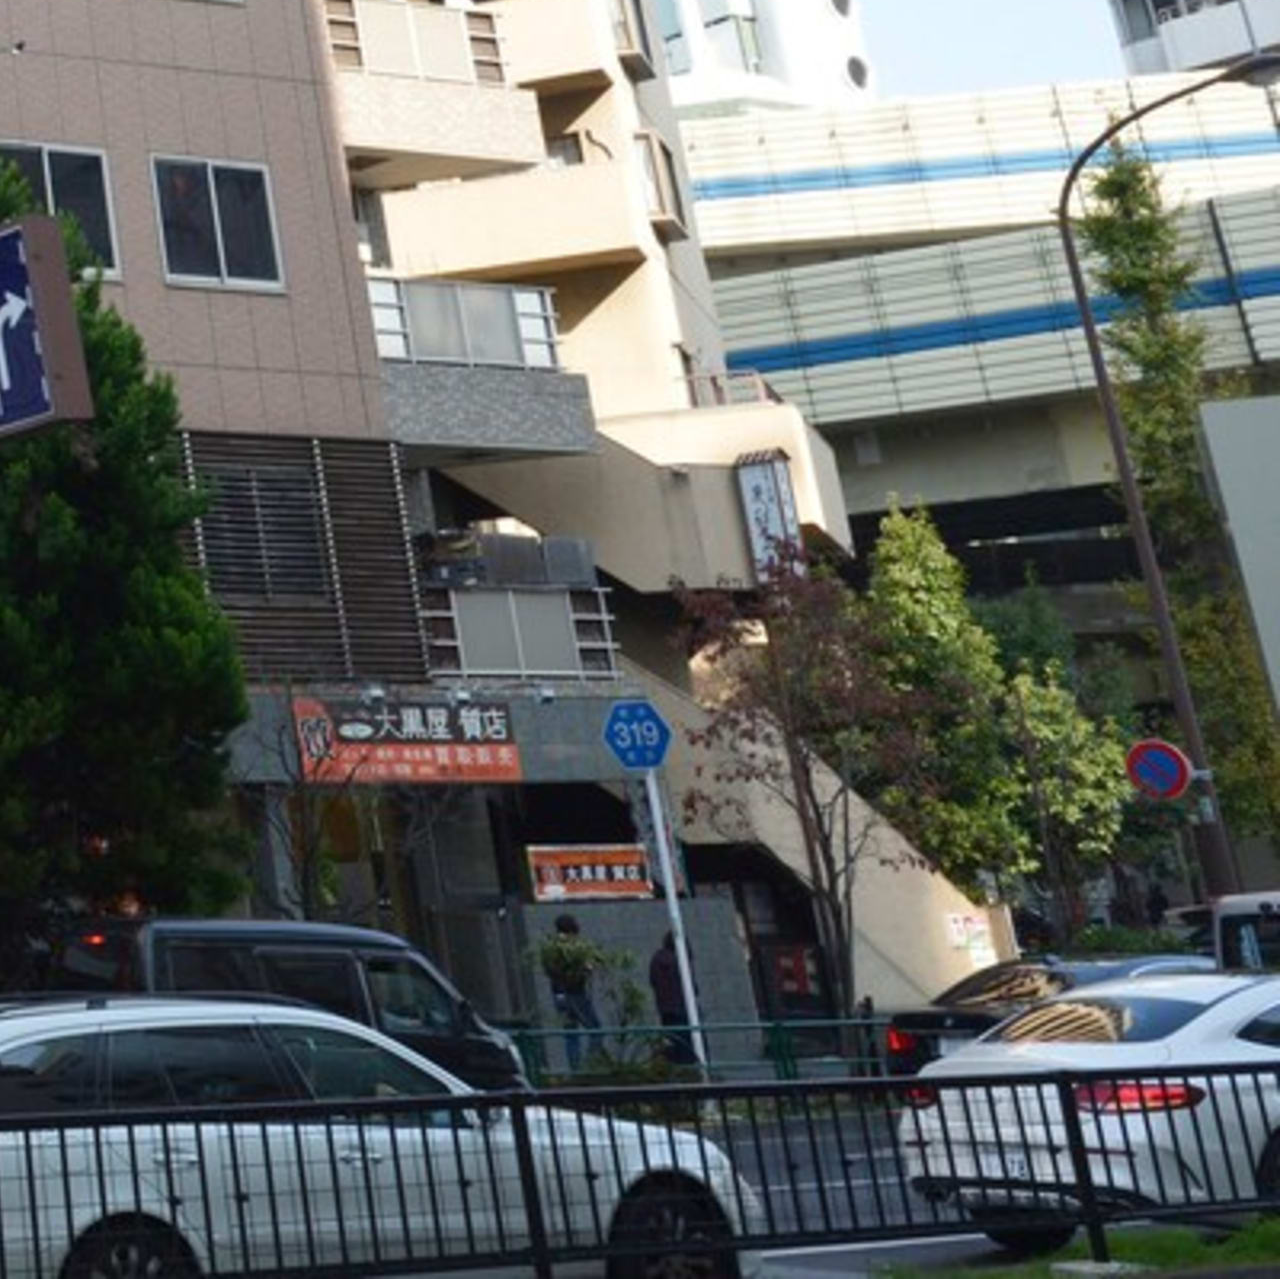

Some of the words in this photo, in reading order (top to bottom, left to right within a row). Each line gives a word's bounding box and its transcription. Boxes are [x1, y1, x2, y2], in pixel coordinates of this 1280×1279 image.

[375, 707, 452, 740] 大黒屋
[613, 721, 660, 748] 319
